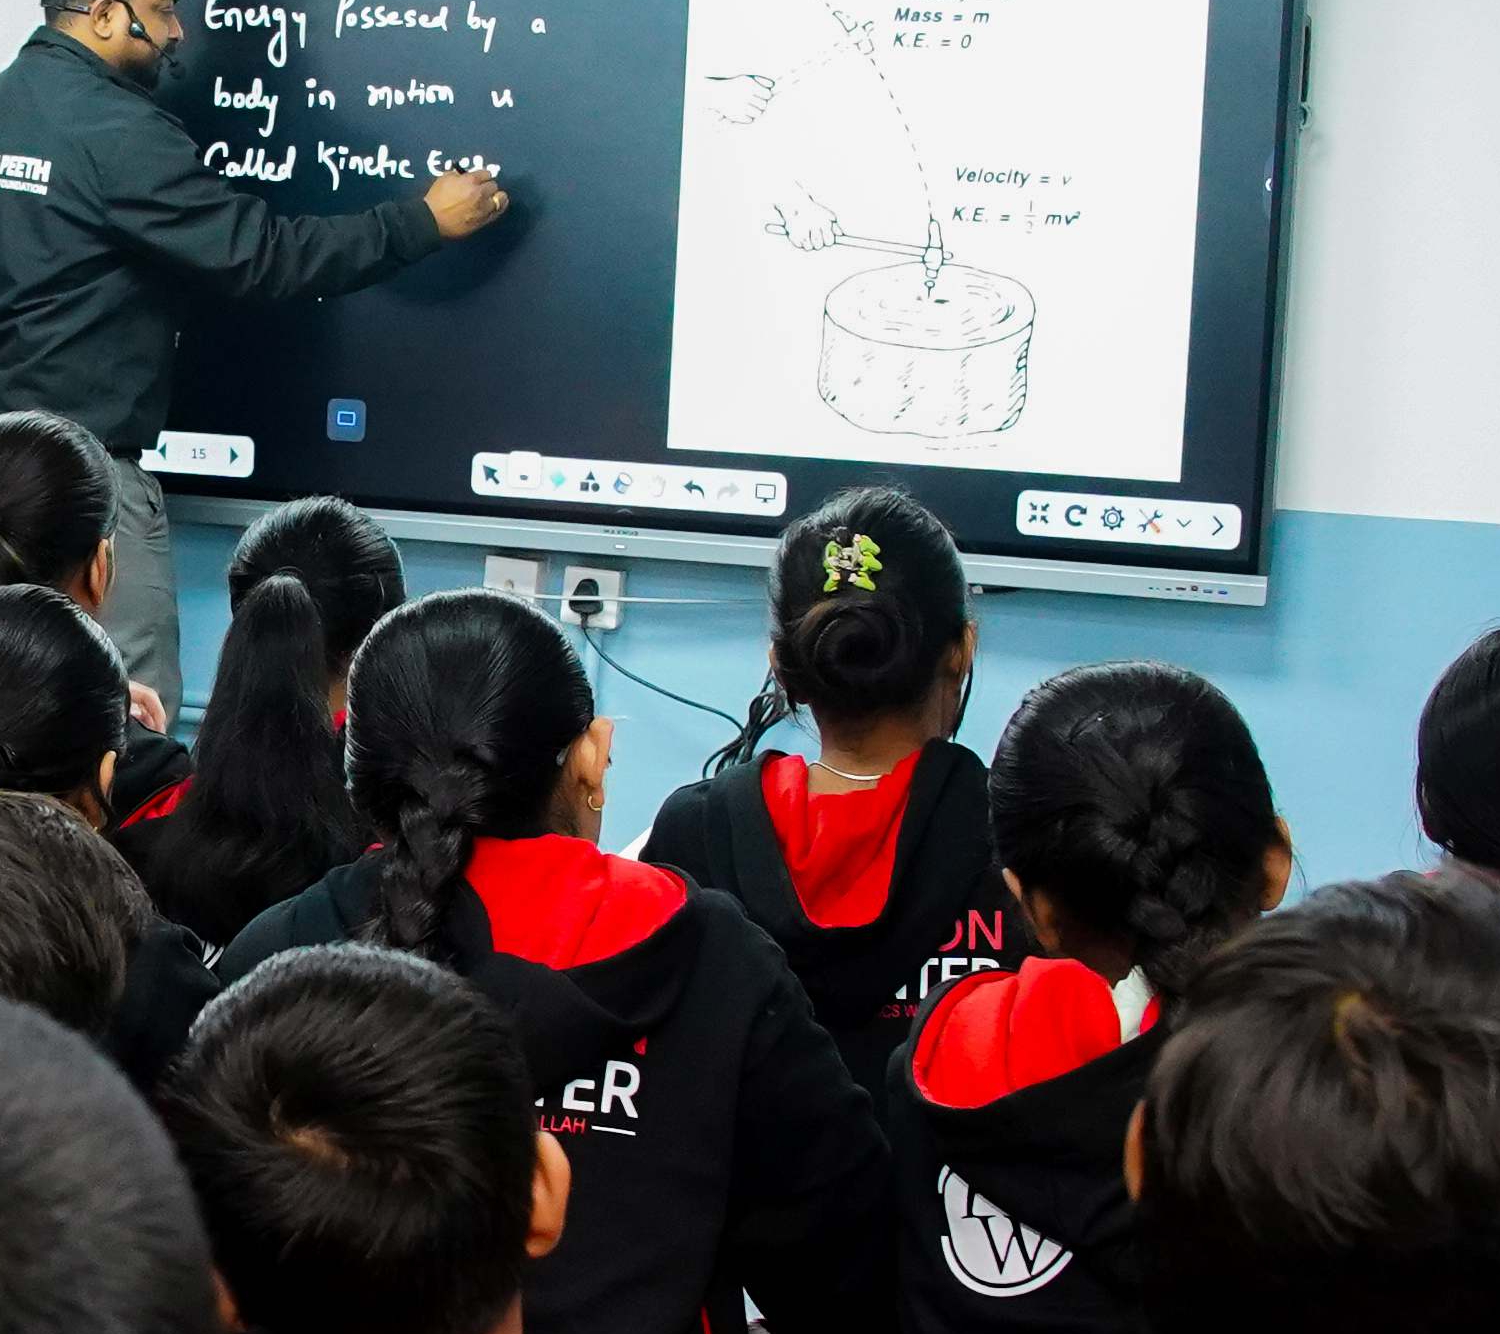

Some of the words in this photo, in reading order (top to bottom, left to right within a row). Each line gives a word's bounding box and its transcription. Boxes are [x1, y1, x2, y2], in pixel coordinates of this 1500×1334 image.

[894, 7, 943, 23] Mass
[972, 11, 990, 24] m
[467, 1, 497, 53] by
[531, 17, 547, 34] a
[893, 33, 930, 48] K.E.
[214, 77, 278, 137] body
[306, 78, 336, 110] in
[367, 79, 454, 110] motion
[204, 141, 297, 182] Called
[317, 141, 415, 191] Kinetic
[955, 167, 1031, 188] Velocity
[952, 207, 989, 223] K.E.
[191, 448, 207, 460] 15
[539, 1114, 587, 1135] LLAH
